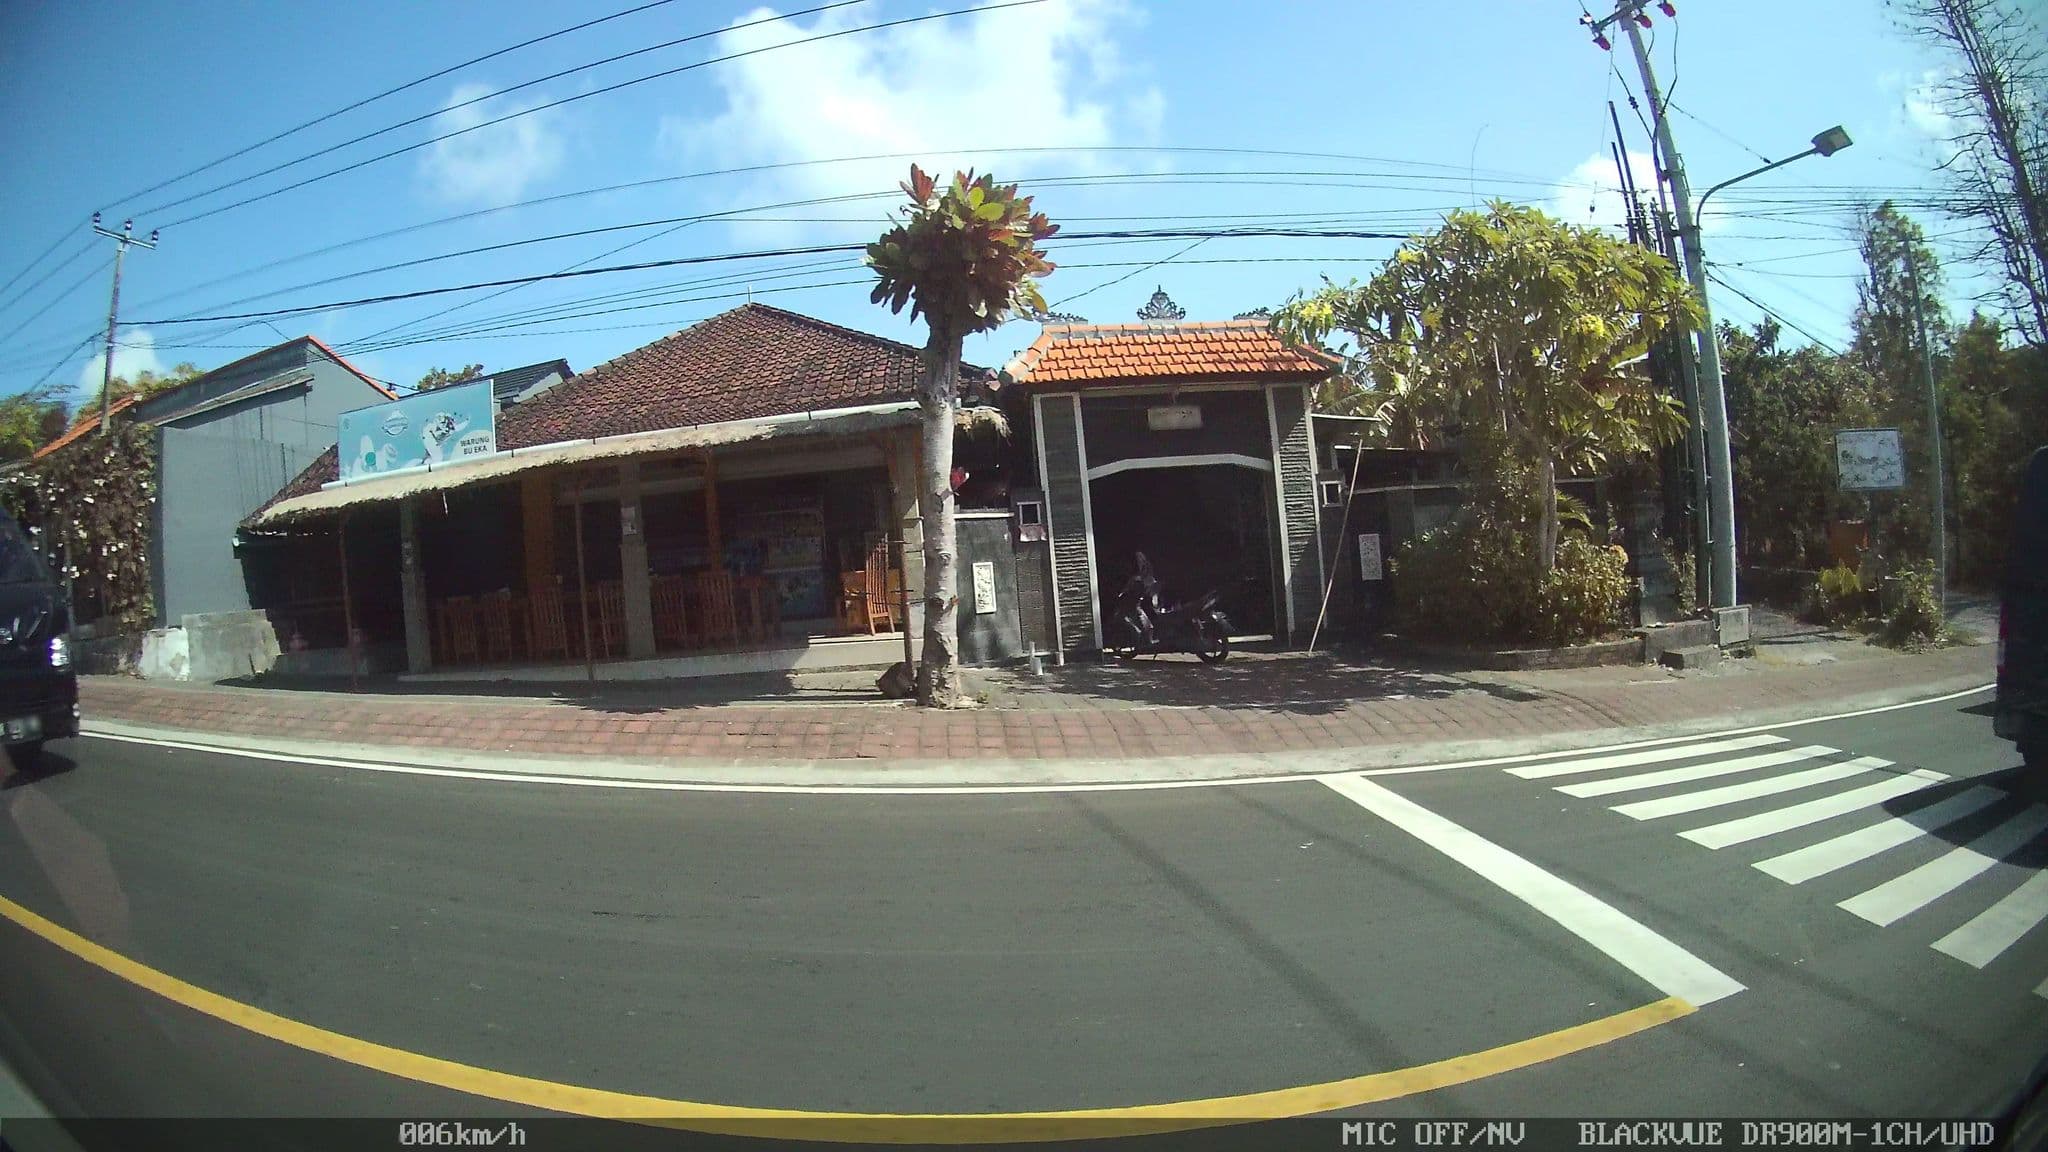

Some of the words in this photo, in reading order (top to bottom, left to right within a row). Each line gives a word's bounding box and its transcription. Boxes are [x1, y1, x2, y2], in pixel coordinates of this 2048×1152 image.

[460, 436, 490, 447] WARUNG
[463, 447, 473, 455] BU
[473, 445, 488, 454] EKA
